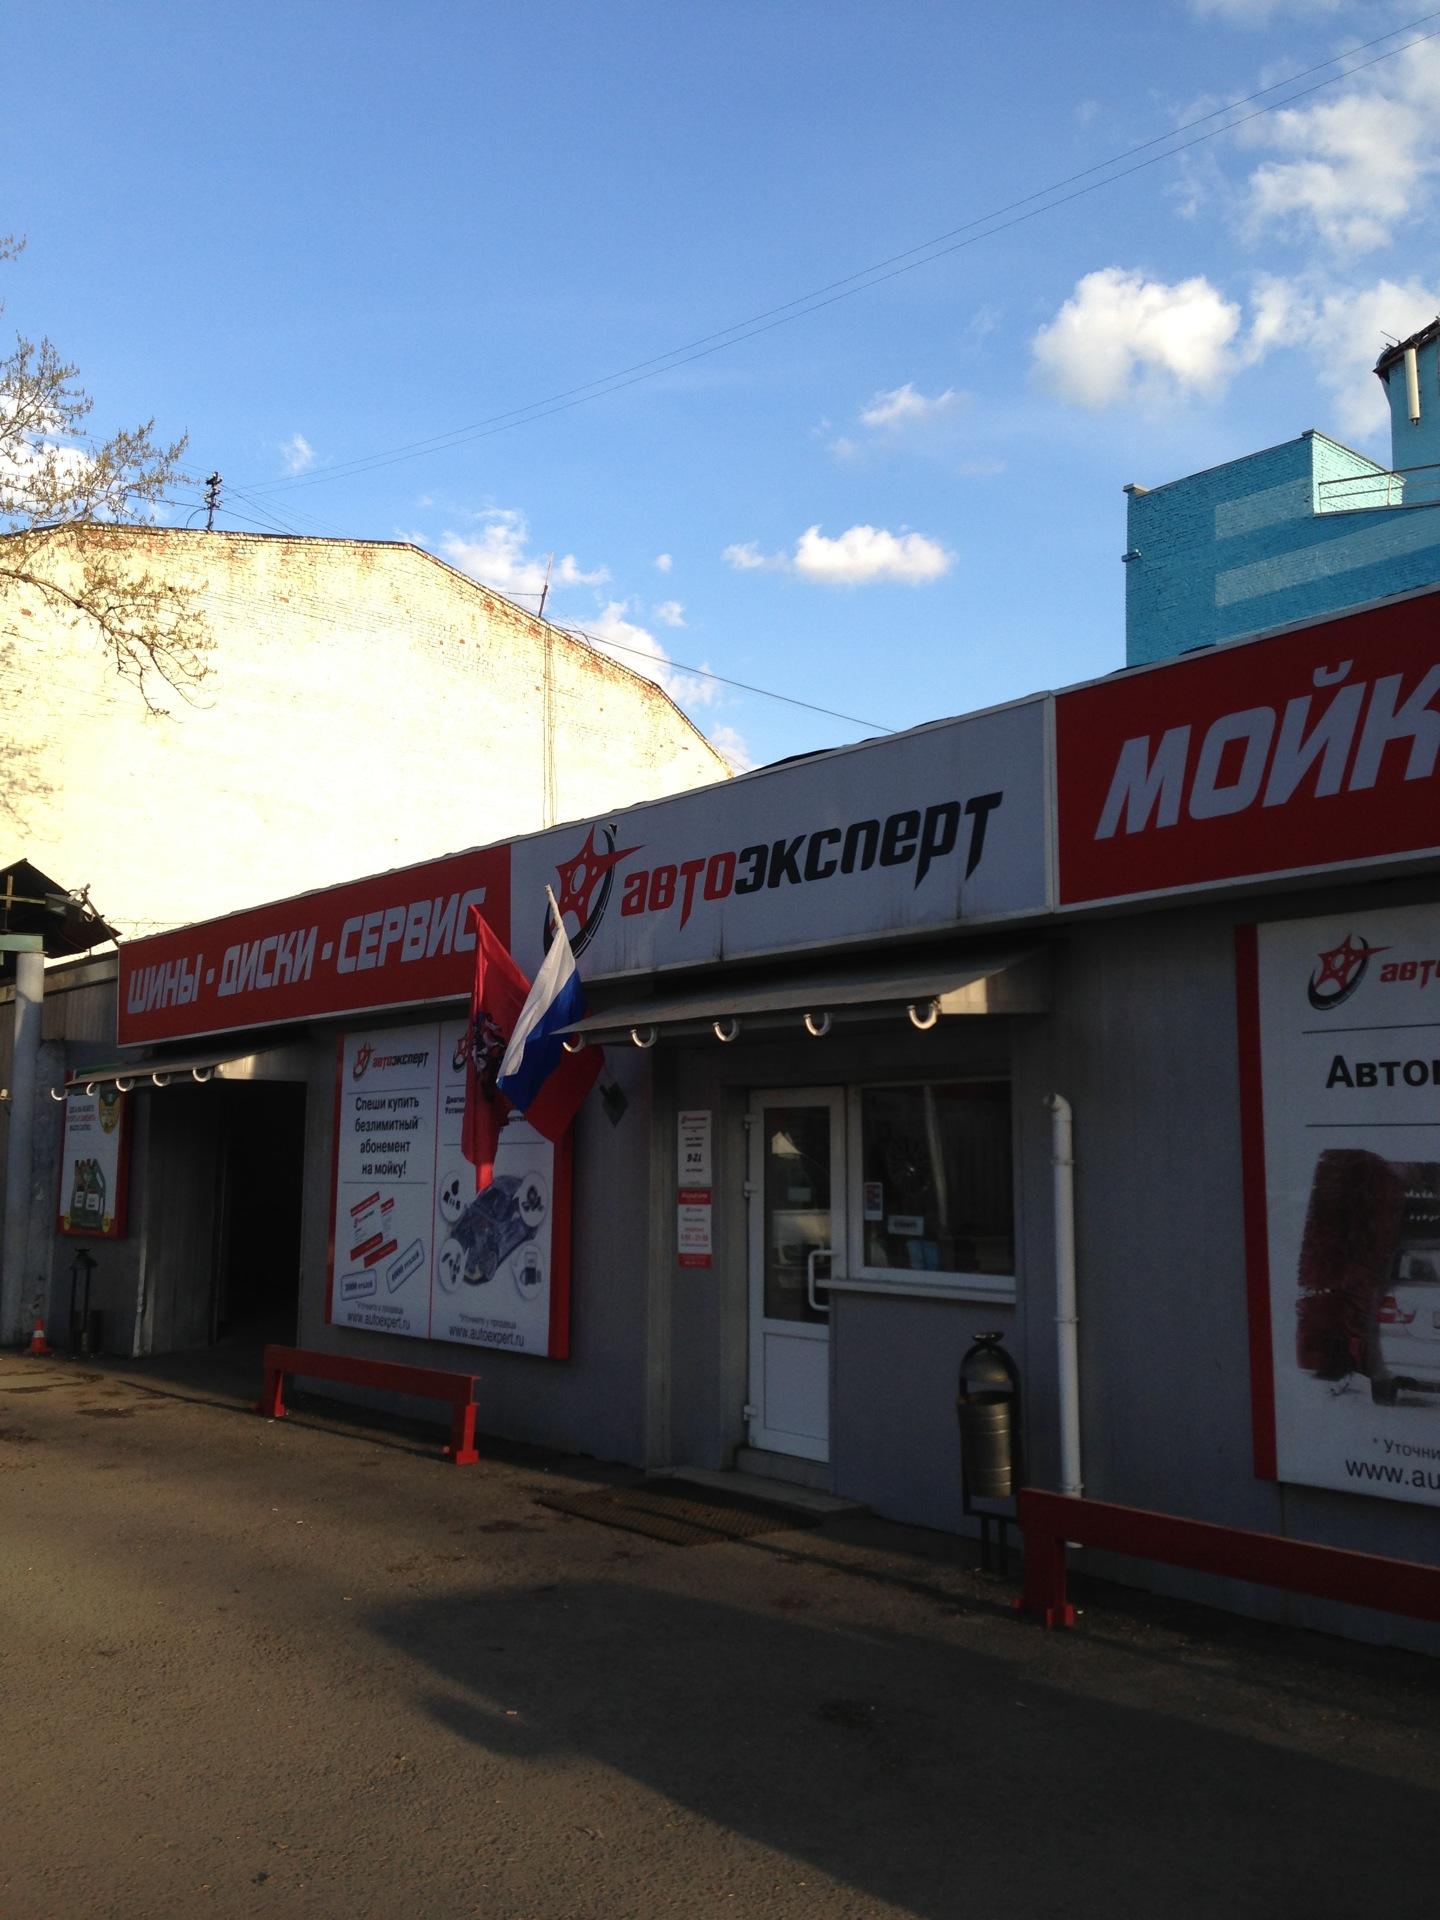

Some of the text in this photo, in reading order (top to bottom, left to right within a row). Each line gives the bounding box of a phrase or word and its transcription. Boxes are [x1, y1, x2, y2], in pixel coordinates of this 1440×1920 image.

[1094, 659, 1440, 840] МОЙК
[620, 791, 1003, 931] автоэксперт
[127, 887, 487, 1014] ШИНЫ ДИСКИ СЕРВИС
[1380, 960, 1440, 990] авт
[356, 1096, 419, 1112] Спеши купить
[355, 1117, 418, 1132] безлимитный
[360, 1139, 411, 1154] абонемент
[362, 1160, 407, 1178] на мойку!
